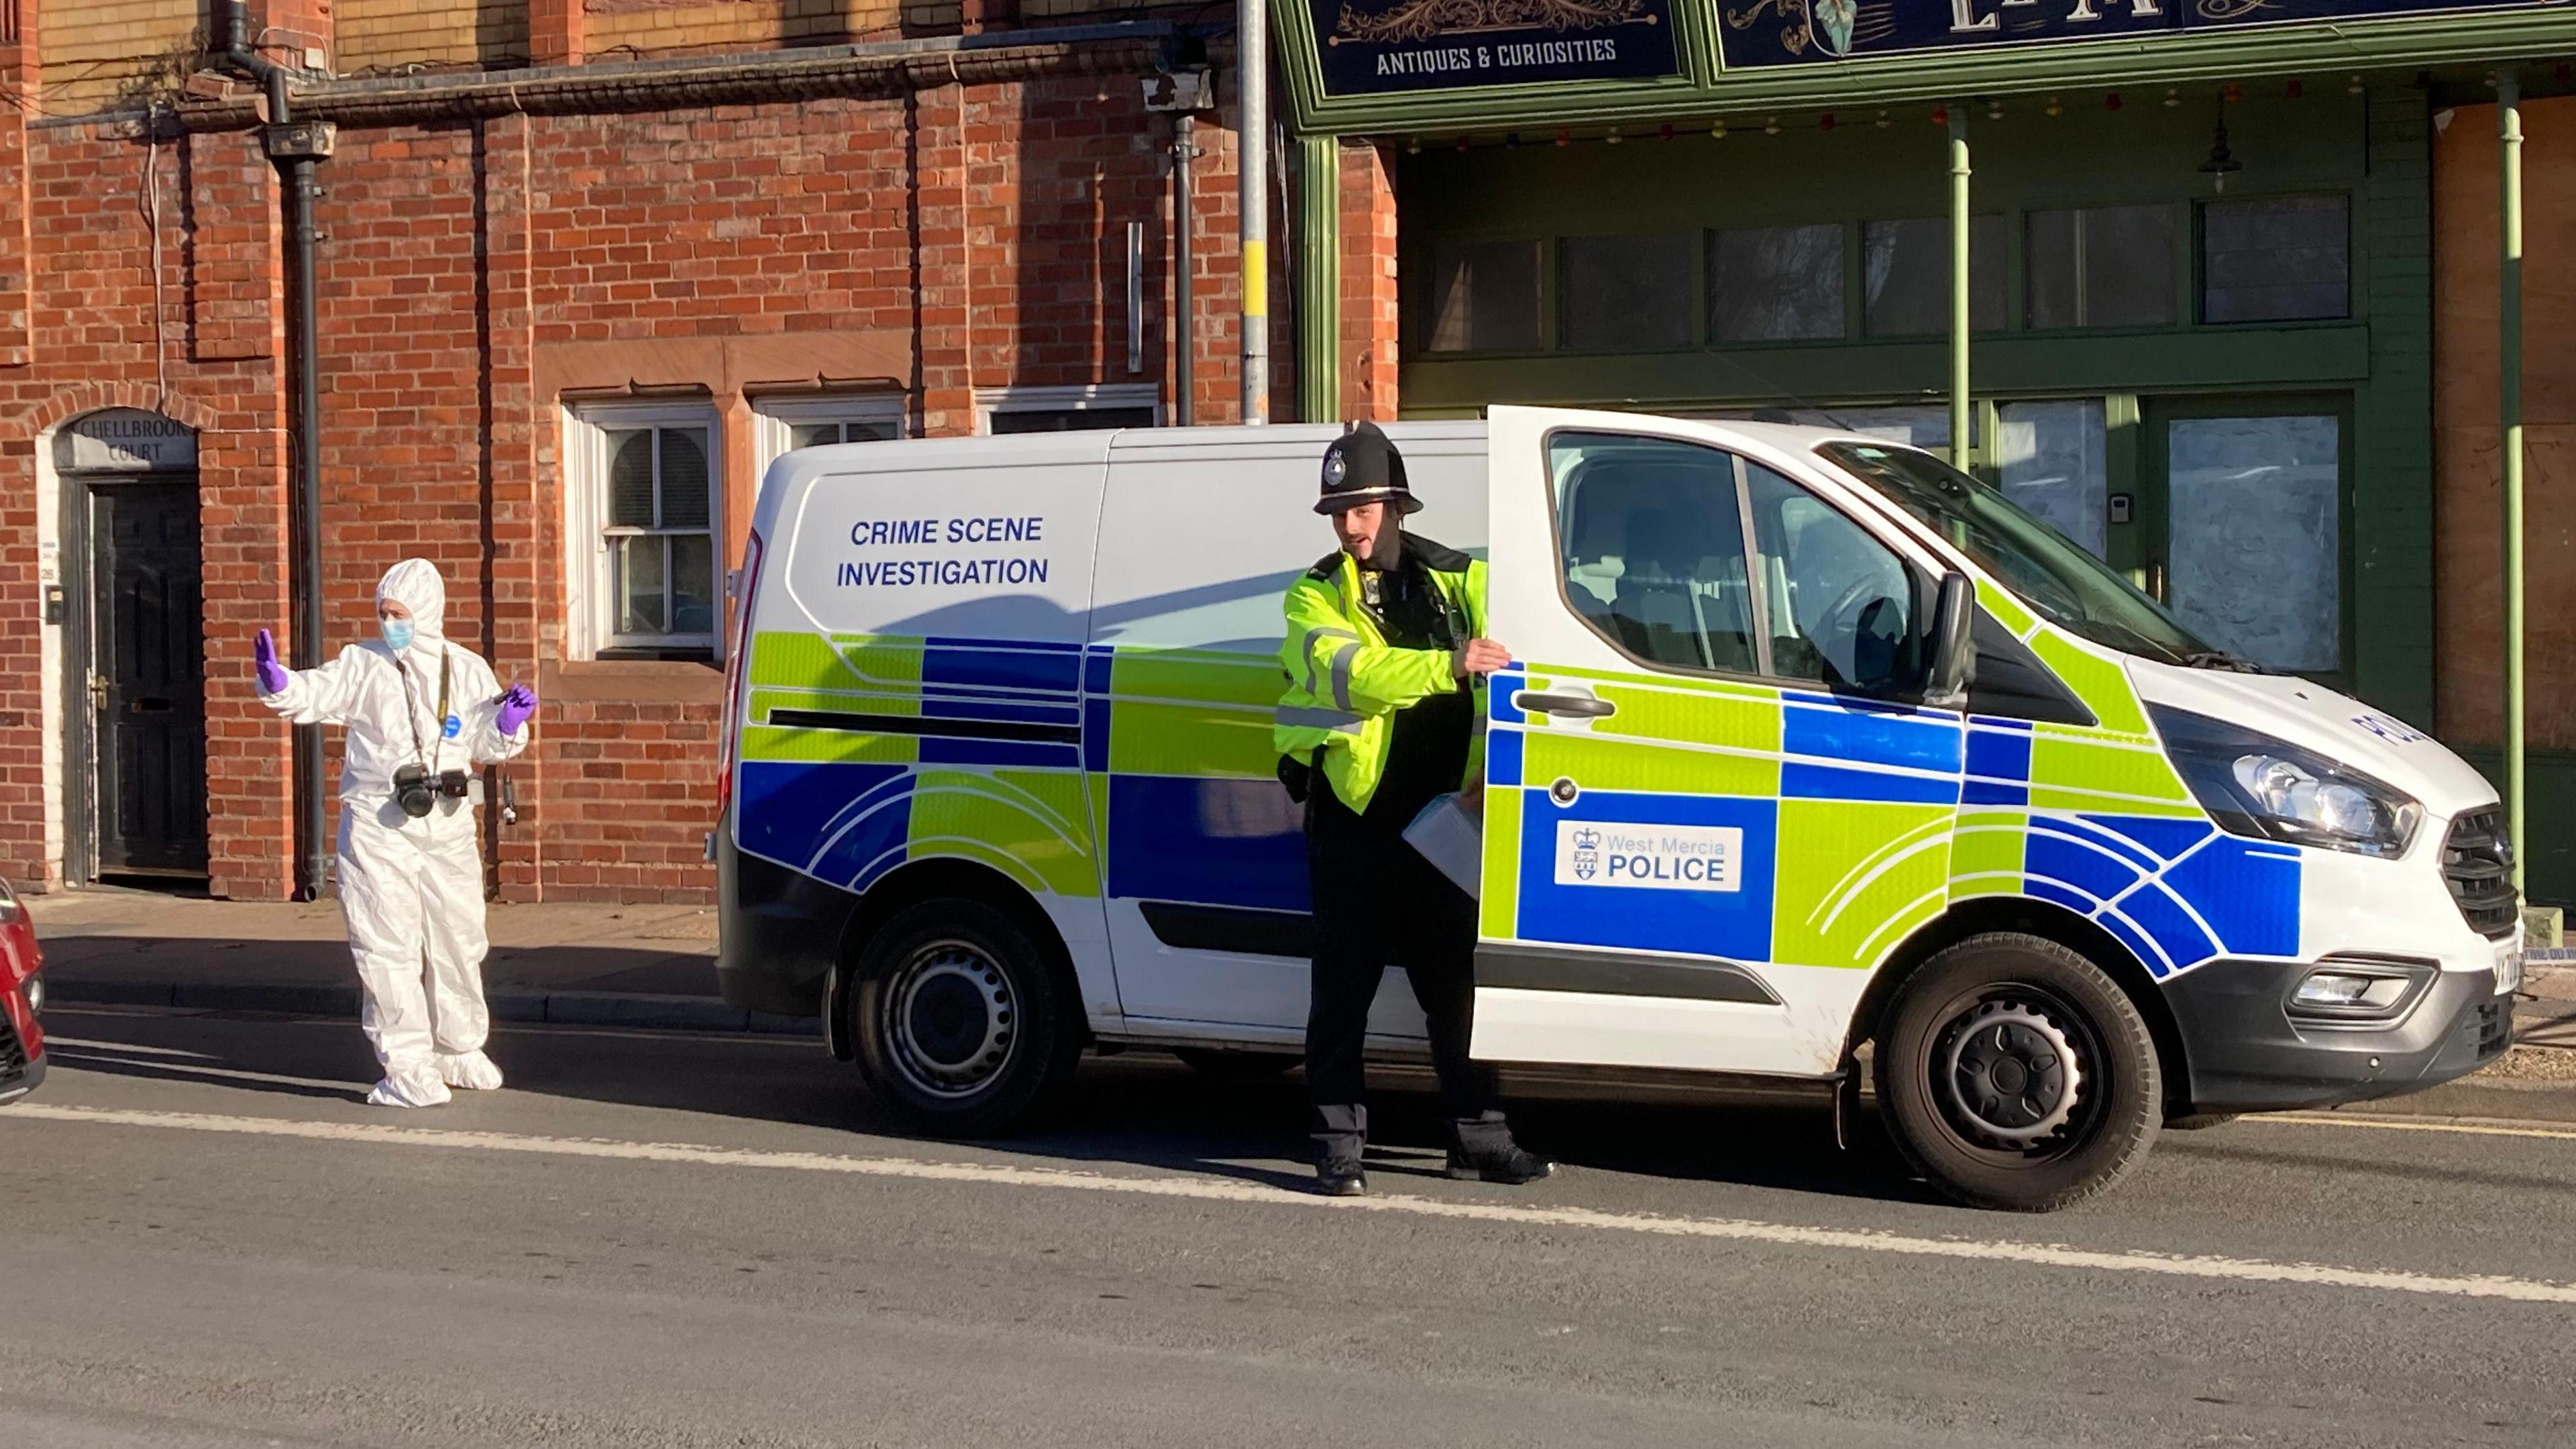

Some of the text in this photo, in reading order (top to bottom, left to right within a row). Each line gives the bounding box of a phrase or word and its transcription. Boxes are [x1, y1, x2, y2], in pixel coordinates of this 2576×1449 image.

[1377, 38, 1617, 75] ANTIQUES & CURIOSITIES
[109, 443, 163, 462] COURT
[851, 517, 1044, 545] CRIME SCENE
[837, 558, 1049, 587] INVESTIGATION
[1607, 834, 1725, 855] West Mercia
[1608, 854, 1725, 882] POLICE
